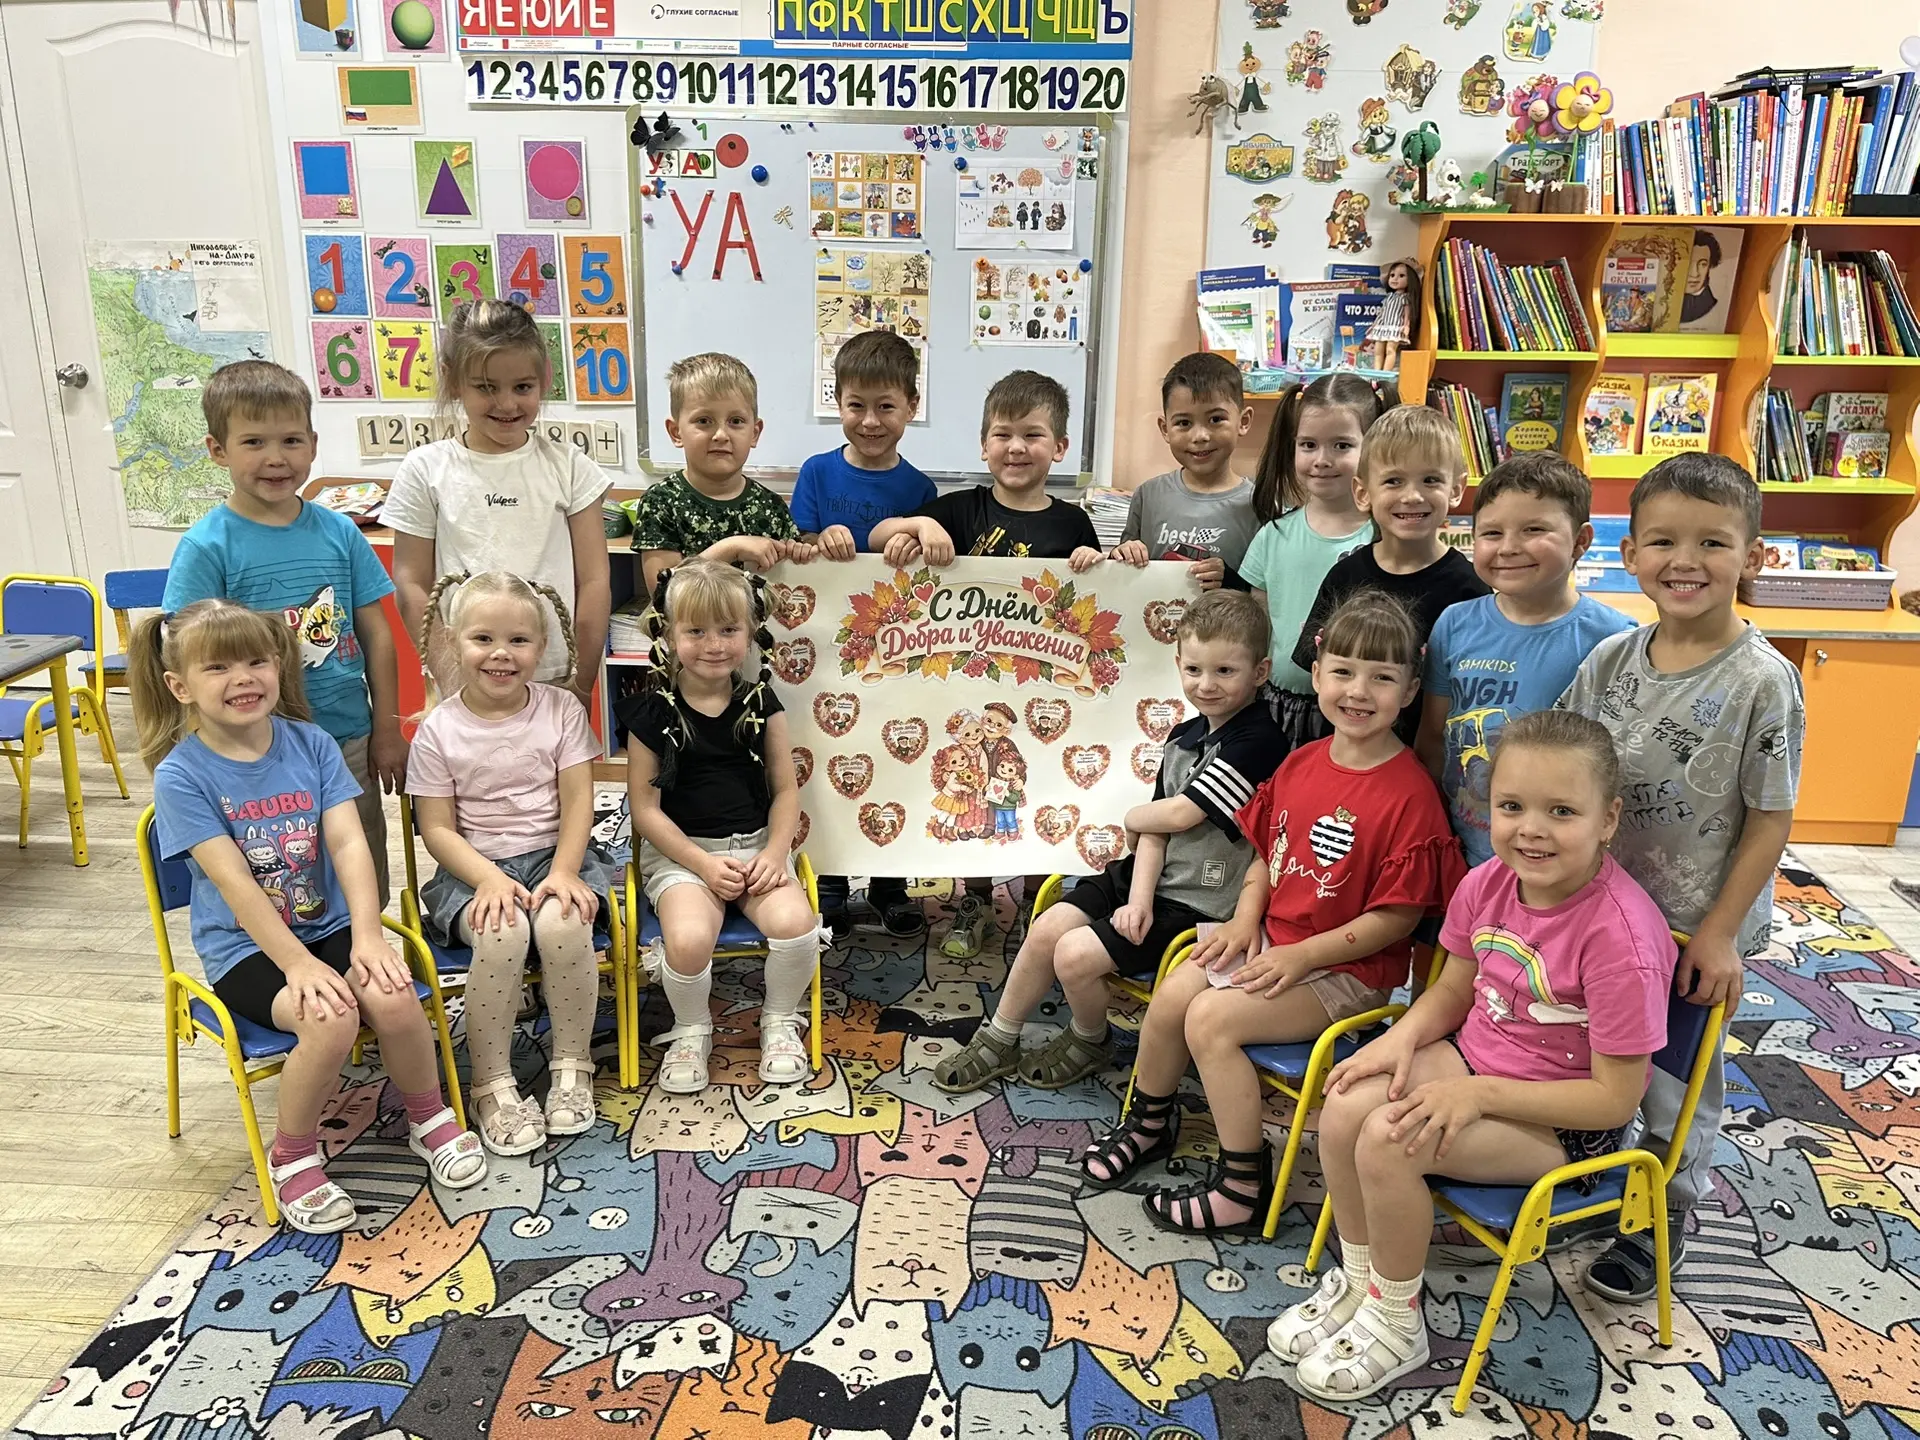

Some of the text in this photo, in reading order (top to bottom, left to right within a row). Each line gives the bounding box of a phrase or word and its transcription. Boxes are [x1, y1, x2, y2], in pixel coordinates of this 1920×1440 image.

[695, 9, 739, 17] СОГЛАСНЫЕ
[864, 41, 909, 49] СОГЛАСНЫЕ
[467, 60, 1125, 111] 1 2 3 4 5 6 7 8 9 10 11 12 13 14 15 16 17 18 19 20
[319, 242, 345, 294] 1
[382, 250, 419, 304] 2
[509, 246, 545, 300] 4
[580, 252, 615, 305] 5
[1610, 276, 1648, 285] СКАЗКИ
[1345, 305, 1362, 316] ЧТО
[326, 334, 630, 396] 6 7 10
[1839, 405, 1879, 415] СКАЗКИ
[366, 419, 380, 446] 1
[388, 418, 405, 445] 2
[1157, 522, 1197, 545] best
[929, 586, 1043, 625] С Днём
[880, 618, 1085, 664] Добра и Уважения
[1457, 658, 1517, 674] SAMIKIDS
